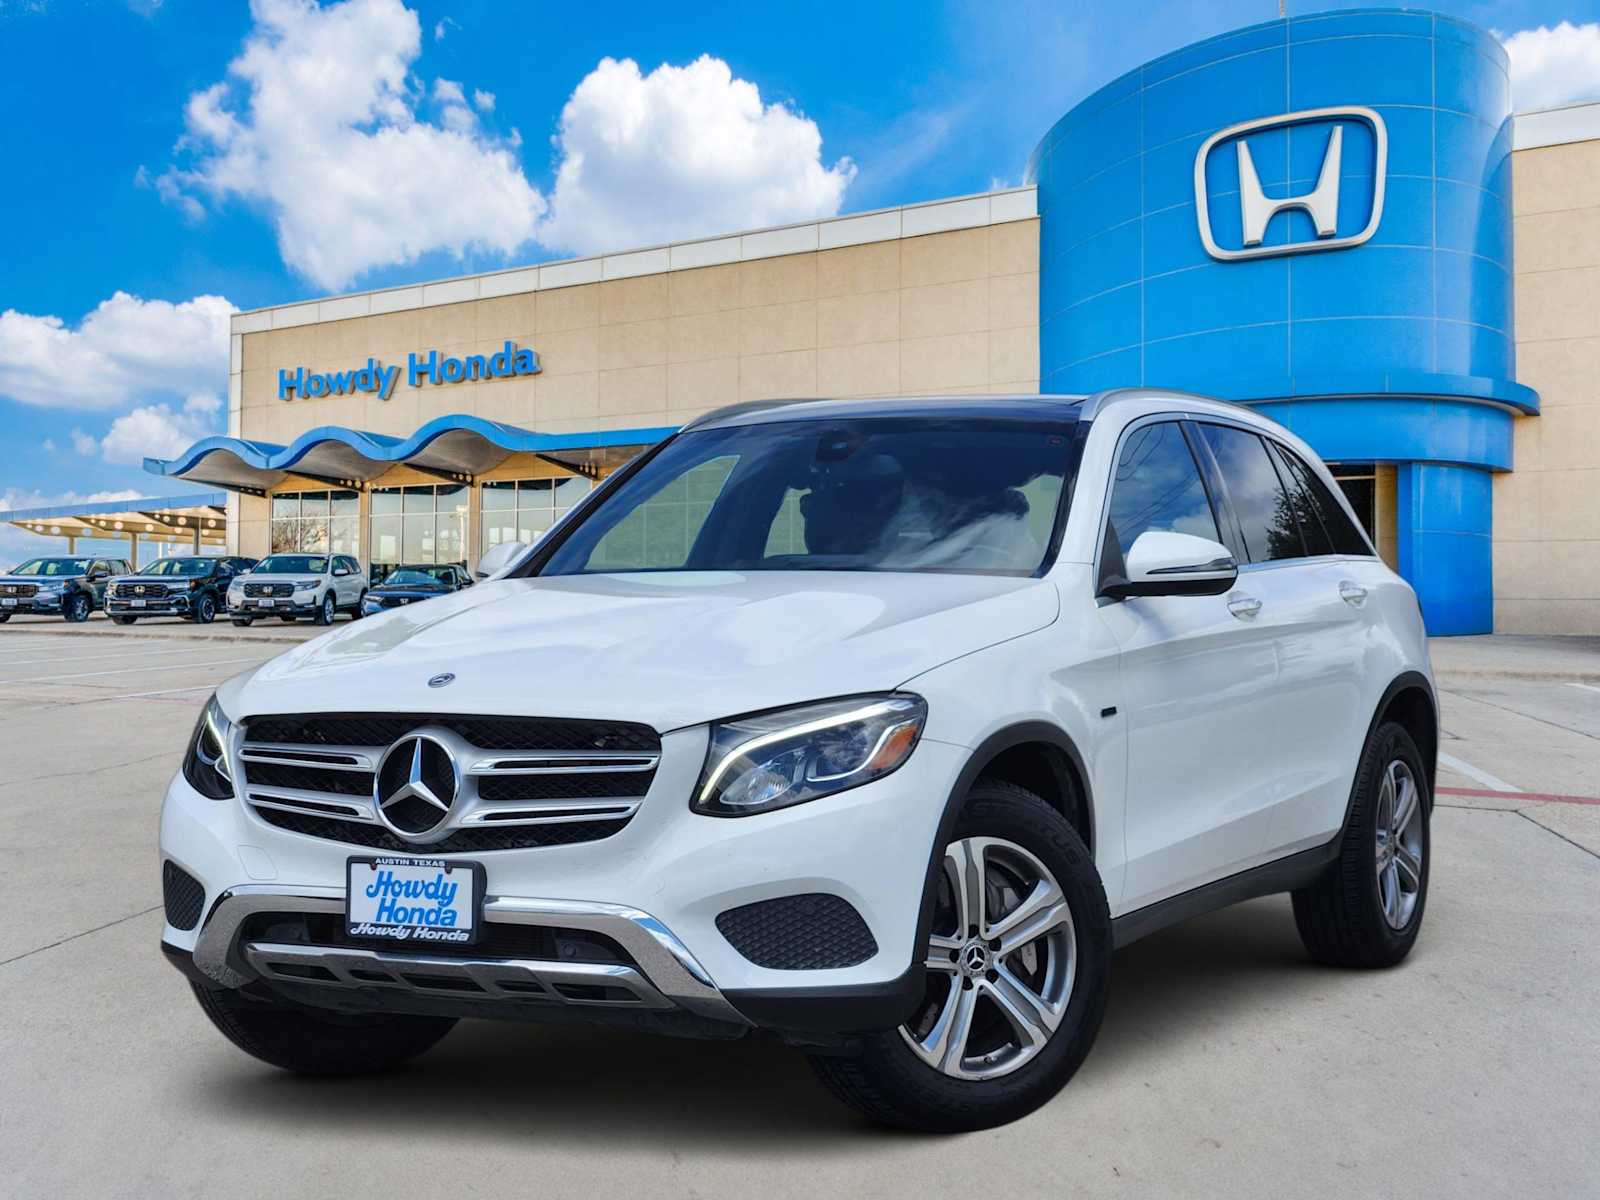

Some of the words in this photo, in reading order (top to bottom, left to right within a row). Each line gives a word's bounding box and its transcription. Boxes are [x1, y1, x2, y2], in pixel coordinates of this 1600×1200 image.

[278, 358, 399, 400] Howdy
[408, 341, 540, 388] Honda
[375, 857, 410, 866] AUSTIN
[412, 859, 446, 867] TEXAS
[366, 870, 458, 907] Howdy
[375, 897, 458, 926] Honda
[350, 922, 411, 940] Howdy
[413, 926, 470, 942] Honda
